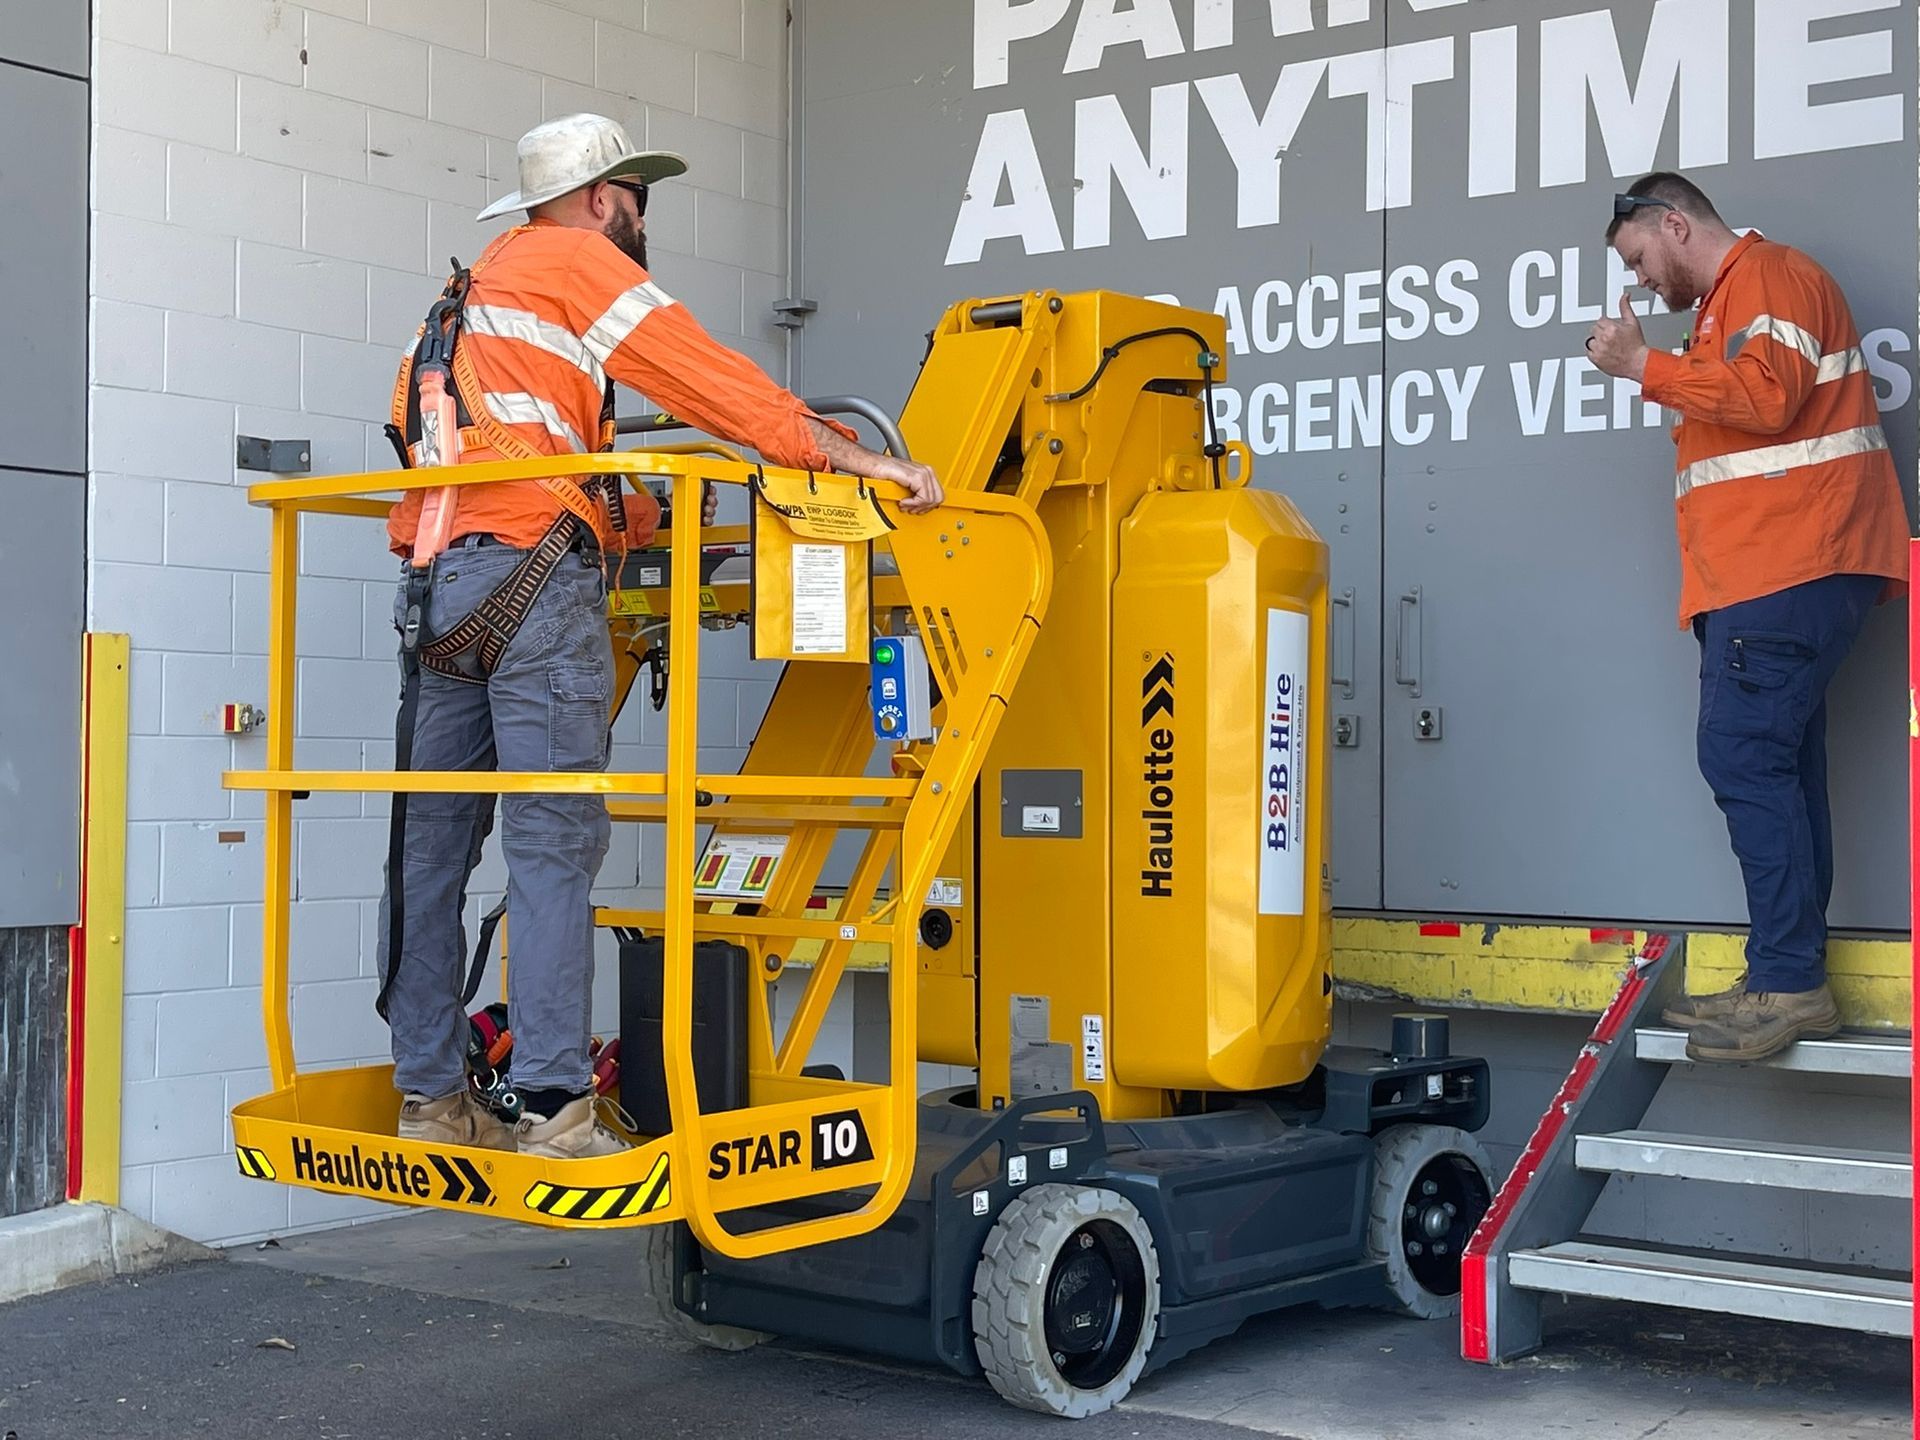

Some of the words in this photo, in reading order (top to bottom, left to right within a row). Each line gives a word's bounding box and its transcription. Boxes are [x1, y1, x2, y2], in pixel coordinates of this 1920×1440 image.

[944, 0, 1904, 266] ANYTIME
[1212, 257, 1480, 356] ACCESS
[806, 505, 822, 515] EWP
[822, 508, 858, 519] LOGBOOK
[877, 704, 904, 719] RESET
[1269, 673, 1291, 752] Hire
[1141, 728, 1175, 898] Haulotte
[1267, 763, 1288, 851] B2B
[292, 1136, 431, 1199] Haulotte
[707, 1129, 802, 1181] STAR
[818, 1119, 858, 1161] 10
